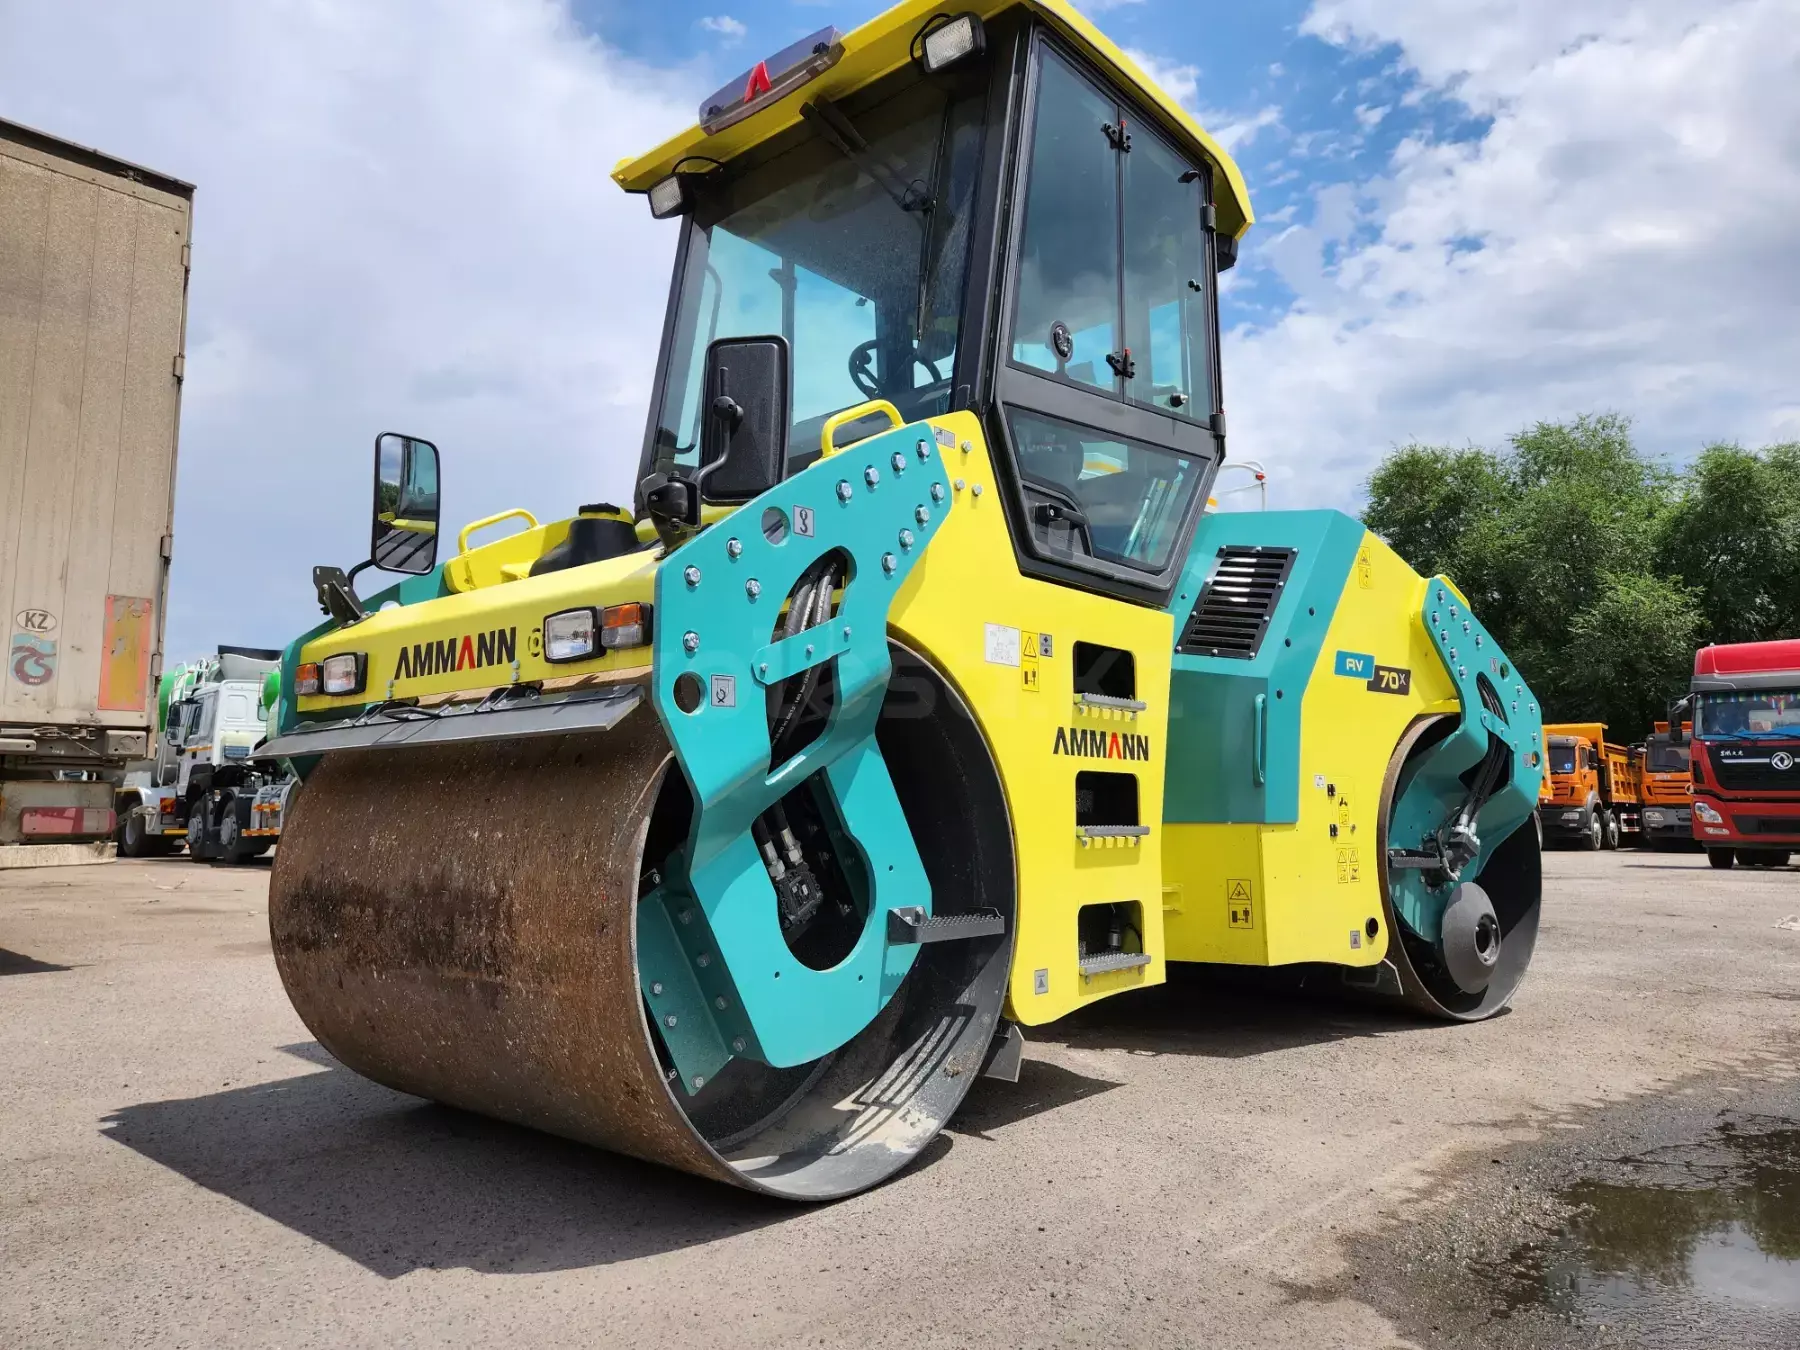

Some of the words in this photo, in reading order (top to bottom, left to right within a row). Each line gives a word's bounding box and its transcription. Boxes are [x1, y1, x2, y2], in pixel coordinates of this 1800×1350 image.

[24, 611, 49, 630] KZ
[394, 626, 517, 680] AMMANN
[1346, 658, 1364, 673] AV
[1053, 727, 1149, 761] AMMANN
